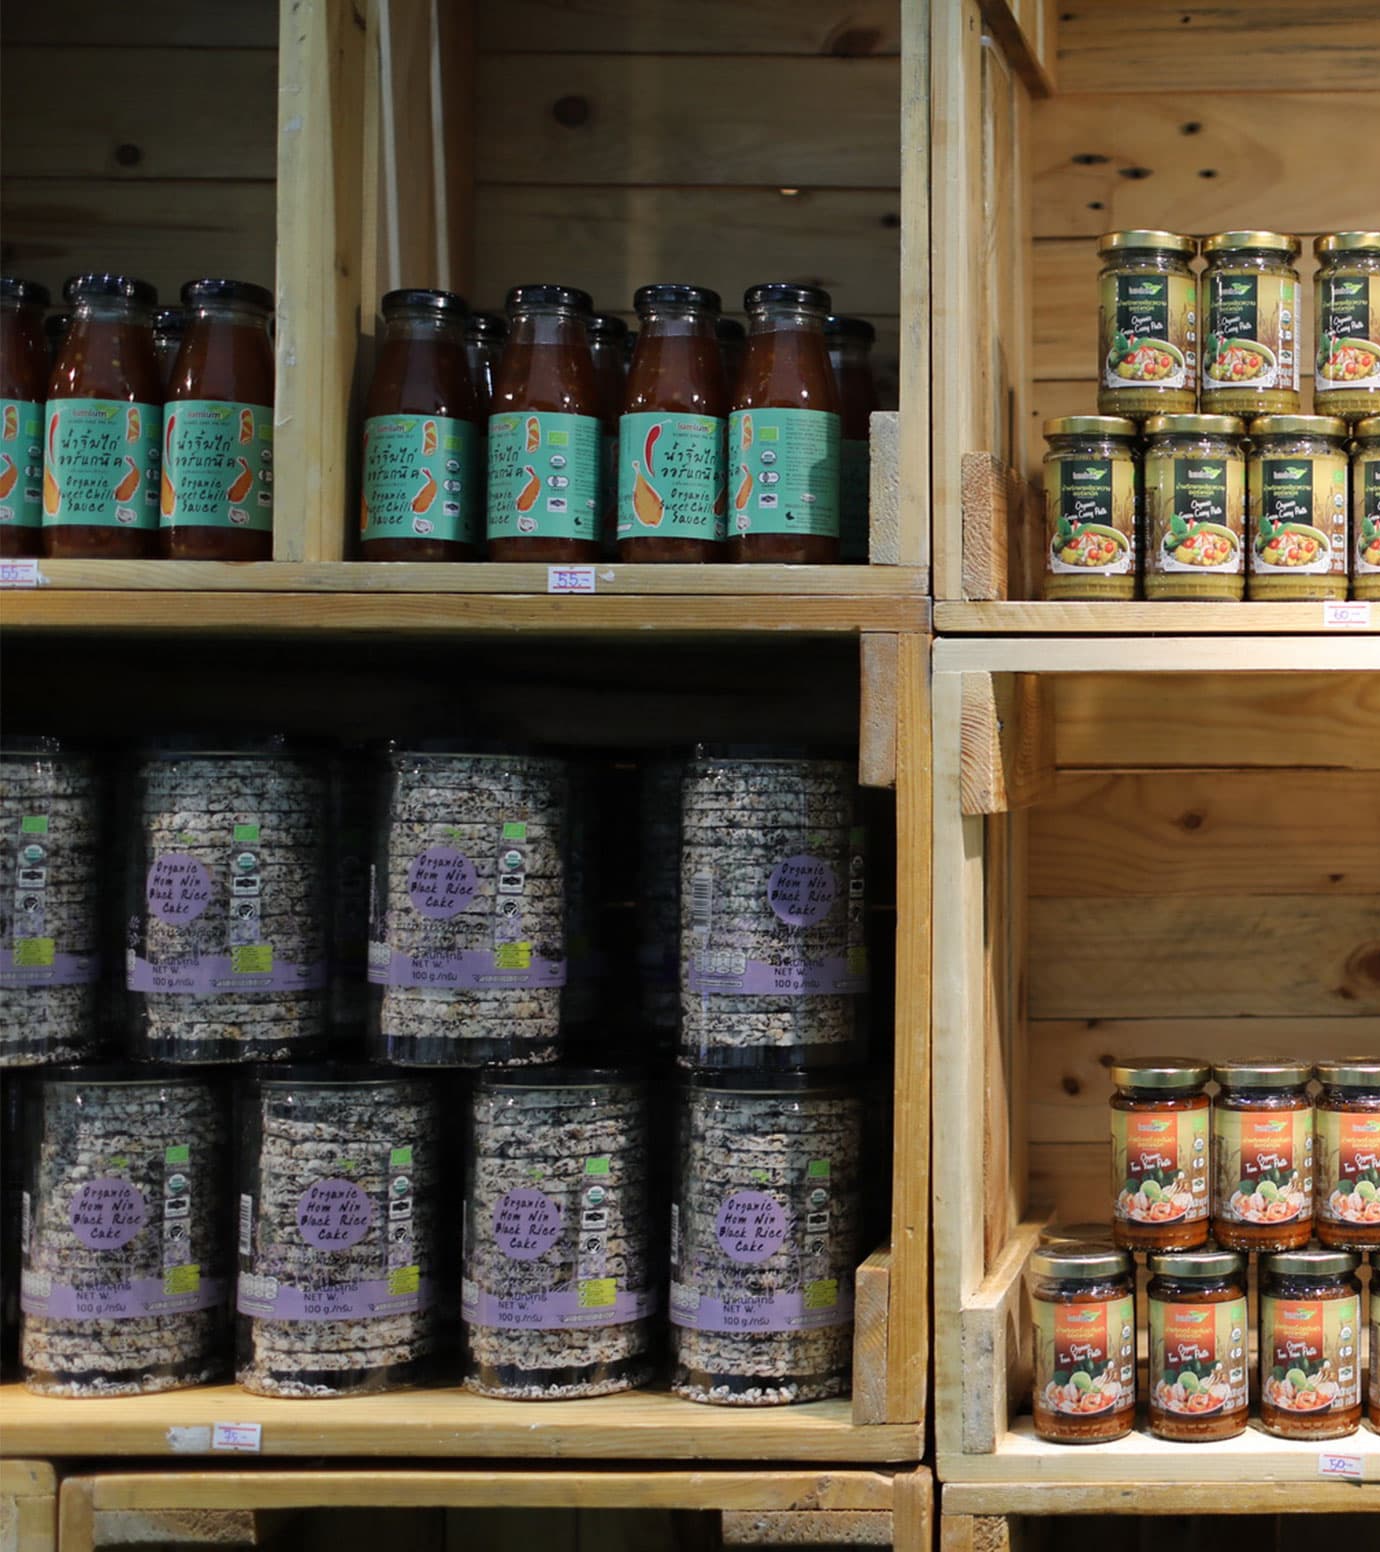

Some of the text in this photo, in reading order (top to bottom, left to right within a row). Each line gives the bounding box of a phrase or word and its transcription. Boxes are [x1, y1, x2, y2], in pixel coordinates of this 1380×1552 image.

[67, 476, 108, 490] Organic
[181, 477, 221, 491] Organic
[372, 492, 406, 502] Organic
[671, 488, 710, 501] Organic
[68, 502, 104, 512] Sauce
[182, 503, 219, 513] Sauce
[372, 513, 402, 524] Sauce
[672, 512, 707, 525] Sauce
[421, 855, 464, 869] Organic
[157, 861, 197, 875] Organic
[416, 870, 466, 880] Hom Nin
[411, 882, 473, 895] Black Rice
[181, 889, 208, 900] Rice
[163, 902, 189, 913] Cake
[426, 897, 454, 908] Cake
[84, 1187, 130, 1199] Organic
[312, 1188, 358, 1201] Organic
[80, 1200, 133, 1210] Hom Nin
[308, 1202, 360, 1211] Hom Nin
[504, 1196, 545, 1209] Organic
[729, 1200, 772, 1213] Organic
[74, 1214, 140, 1224] Black Rice
[301, 1215, 367, 1225] Black Rice
[501, 1211, 549, 1221] Hom Nin
[725, 1213, 775, 1224] Hom Nin
[91, 1228, 120, 1238] Cake
[495, 1222, 555, 1235] Black Rice
[720, 1227, 781, 1238] Black Rice
[319, 1229, 349, 1240] Cake
[510, 1238, 536, 1248] Cake
[736, 1241, 763, 1251] Cake
[77, 1304, 93, 1312] 100
